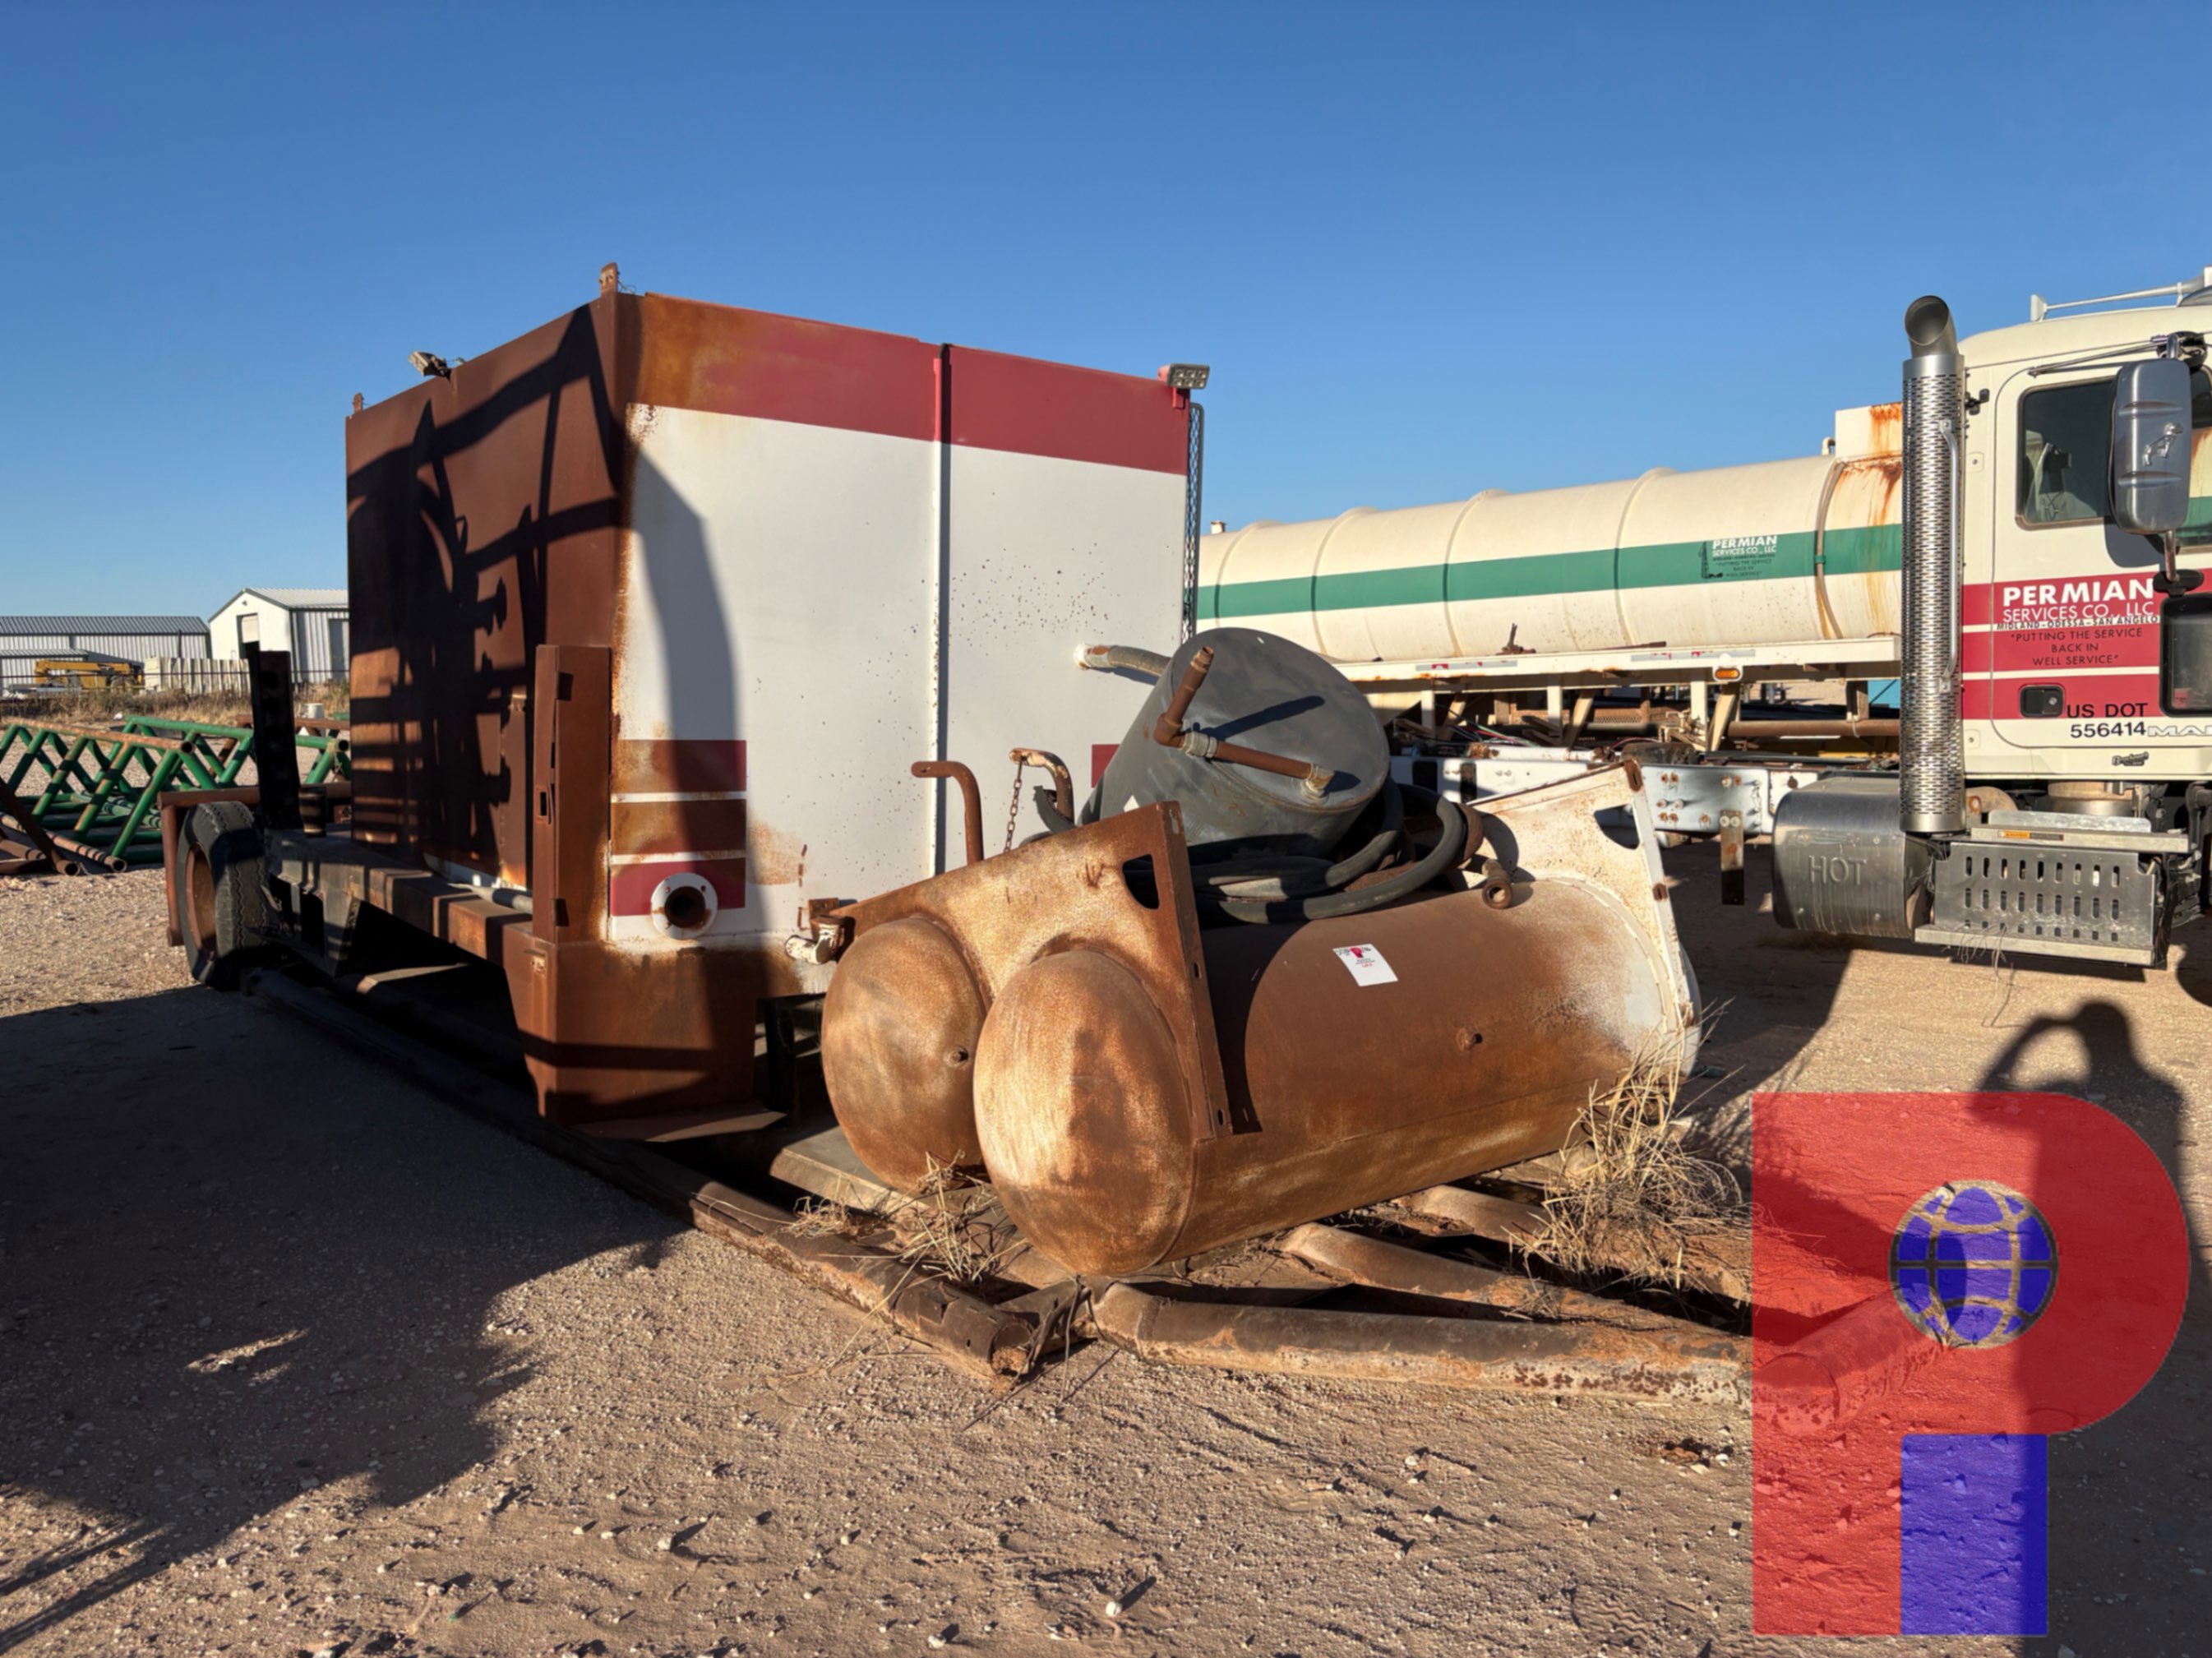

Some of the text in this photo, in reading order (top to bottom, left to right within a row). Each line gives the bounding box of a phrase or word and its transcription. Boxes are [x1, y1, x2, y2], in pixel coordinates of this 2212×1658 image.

[1712, 535, 1778, 549] PERMIAN
[1712, 547, 1744, 557] SERVICES
[1764, 544, 1777, 553] LLC
[2003, 578, 2154, 607] PERMIAN
[2002, 606, 2078, 623] SERVICES
[2127, 602, 2154, 616] LLC
[2117, 616, 2159, 625] ANGELO
[2070, 630, 2090, 640] THE
[2094, 628, 2143, 640] SERVICE
[2051, 643, 2099, 654] BACK IN
[2032, 657, 2061, 666] WELL
[2067, 703, 2149, 718] US DOT
[2071, 721, 2147, 738] 556414
[2148, 725, 2212, 737] MA
[1808, 855, 1868, 885] HOT
